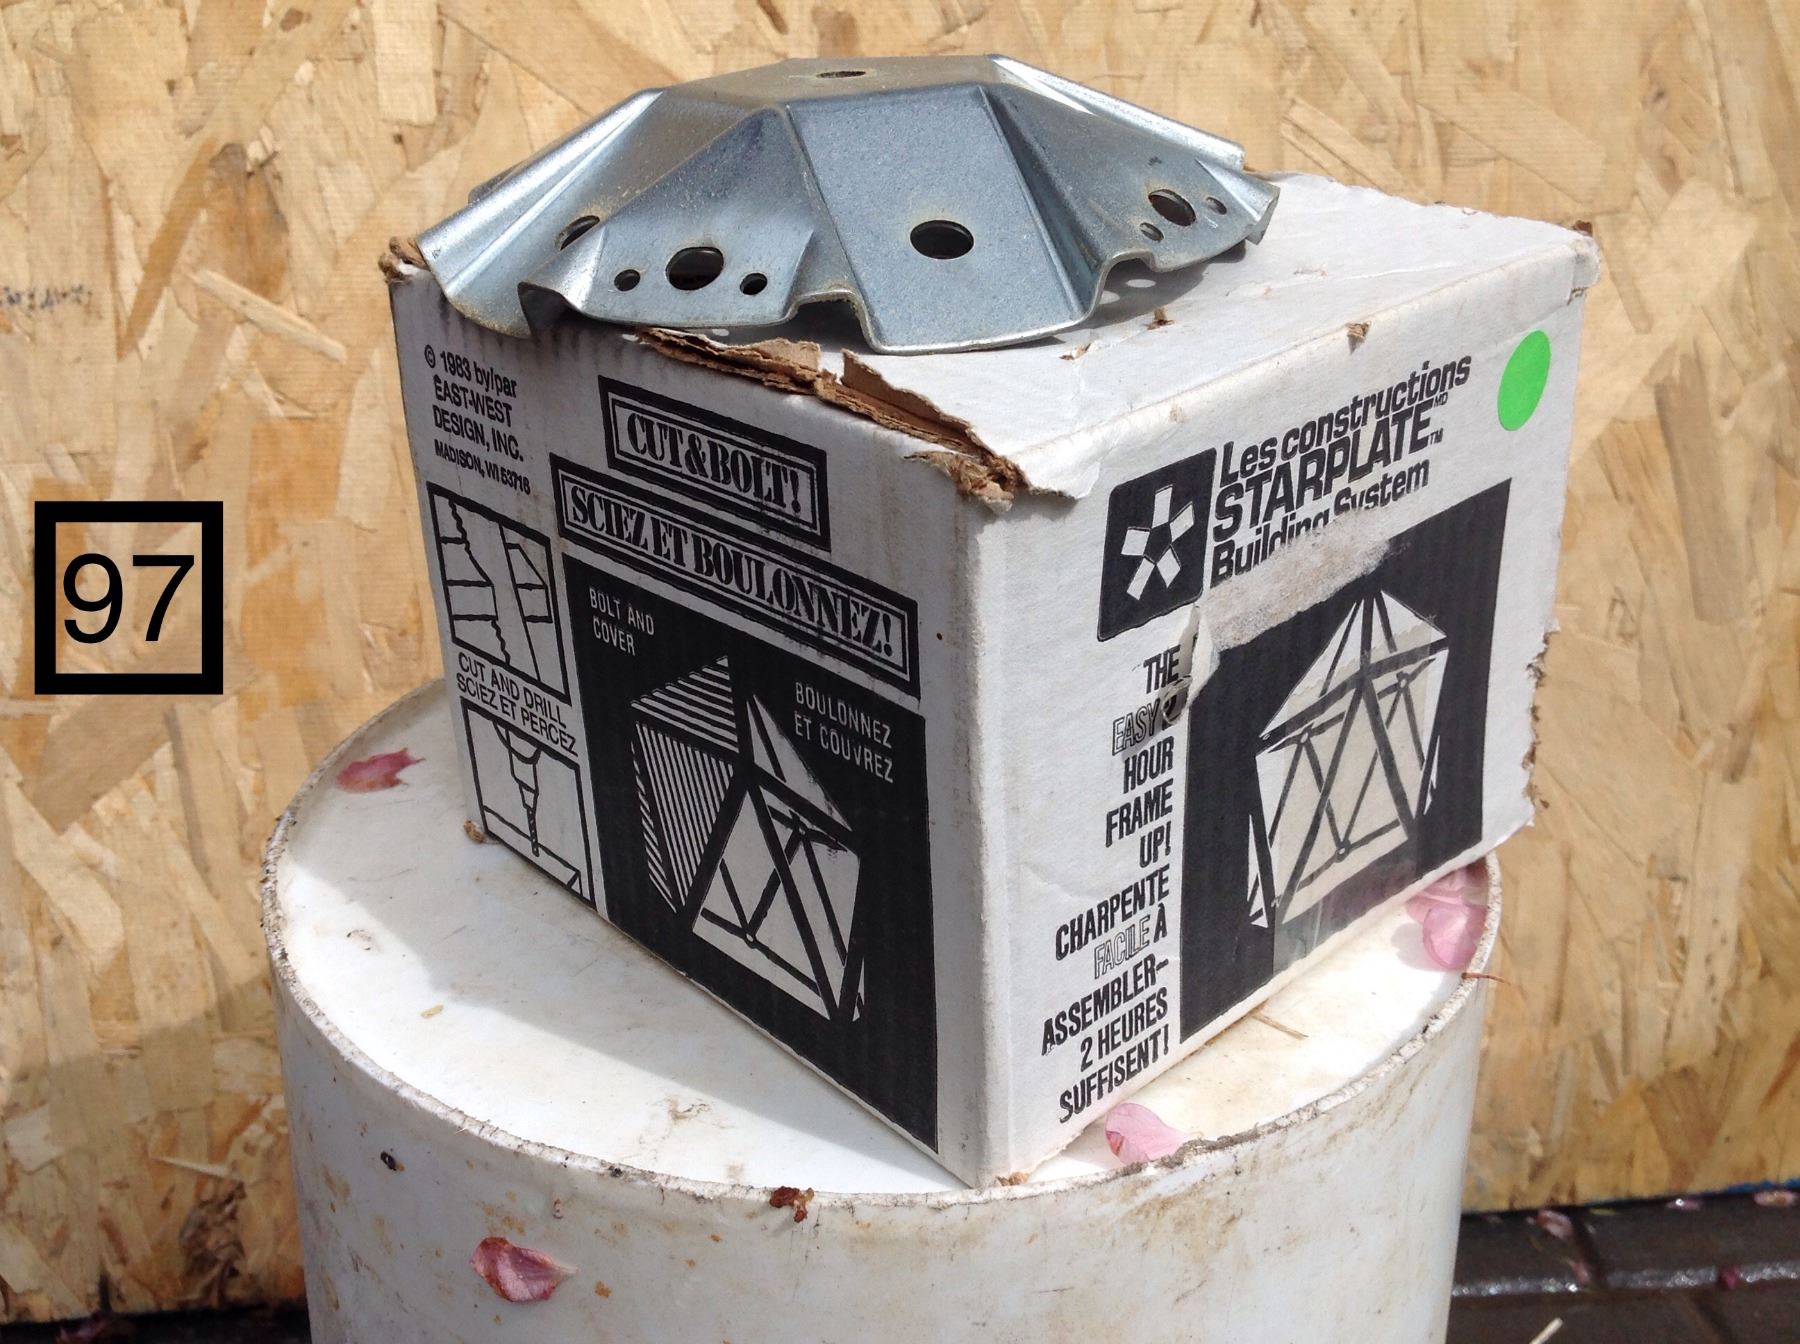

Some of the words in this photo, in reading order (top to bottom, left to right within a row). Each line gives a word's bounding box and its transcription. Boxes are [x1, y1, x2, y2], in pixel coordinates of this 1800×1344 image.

[440, 351, 472, 381] 1983
[433, 375, 512, 427] EAST-WEST
[433, 404, 490, 452] DESIGN,
[492, 428, 524, 461] INC.
[1220, 437, 1278, 488] Les
[1280, 355, 1472, 461] constructions
[434, 439, 485, 477] MADISON,
[485, 460, 499, 482] WI
[1213, 397, 1434, 542] STARPLATE
[571, 485, 649, 550] SCIEZ
[651, 515, 688, 568] ET
[691, 532, 894, 657] BOULONNEZ!
[589, 586, 622, 621] BOLT
[627, 605, 655, 636] AND
[592, 617, 636, 656] COVER
[458, 651, 485, 682] CUT
[491, 669, 520, 700] AND
[523, 687, 566, 729] DRILL
[1143, 644, 1181, 694] THE
[456, 673, 498, 710] SCIEZ
[499, 694, 516, 720] ET
[520, 707, 578, 757] PERCEZ
[794, 710, 812, 740] ET
[819, 723, 894, 784] COUVREZ
[795, 681, 892, 749] BOULONNEZ
[1112, 698, 1161, 756] EASY
[1123, 735, 1174, 794] HOUR
[1106, 778, 1174, 848] FRAME
[1139, 821, 1171, 868] UP!
[1056, 863, 1170, 961] CHARPENTE
[1094, 914, 1151, 980] FACILE
[1042, 953, 1169, 1056] ASSEMBLER-
[1080, 1036, 1093, 1072] 2
[1098, 987, 1168, 1059] HEURES
